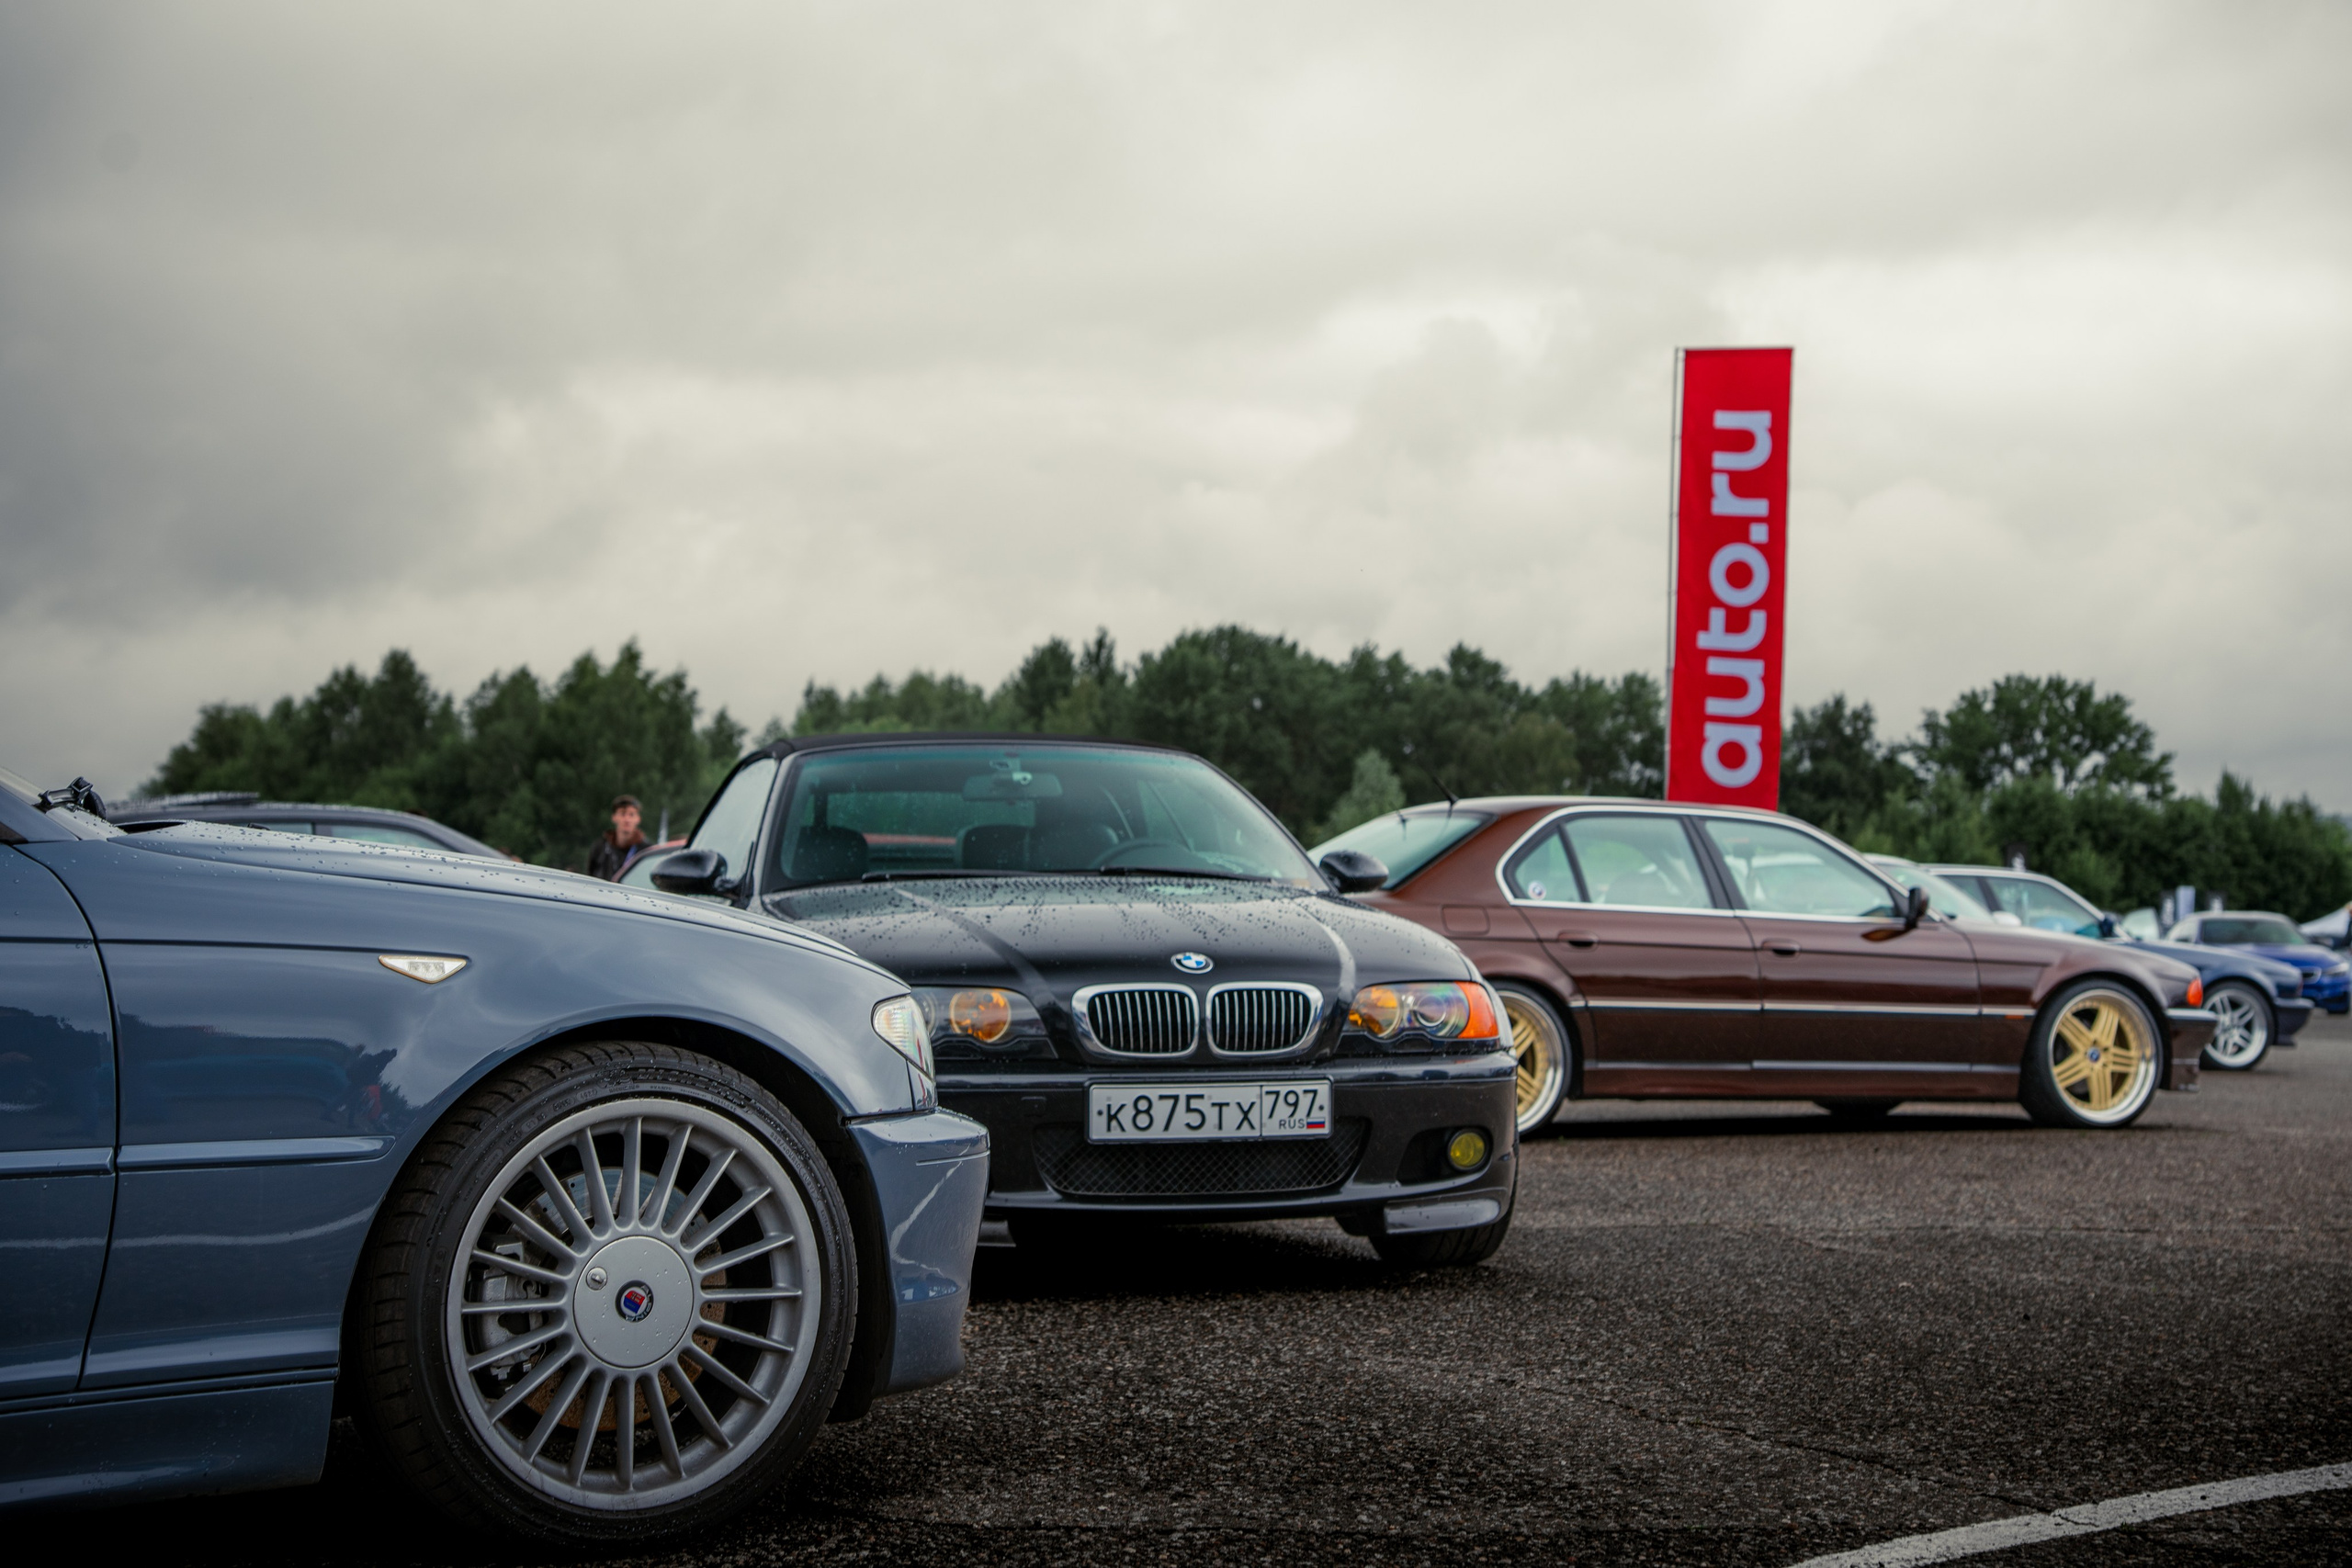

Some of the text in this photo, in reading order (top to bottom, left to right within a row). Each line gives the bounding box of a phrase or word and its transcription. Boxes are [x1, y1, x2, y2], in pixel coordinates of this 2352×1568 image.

[1696, 410, 1773, 788] auto.ru
[1106, 1095, 1256, 1132] K875TX
[1264, 1089, 1318, 1119] 797
[1279, 1119, 1305, 1129] RUS
[625, 1284, 652, 1322] ALPINA
